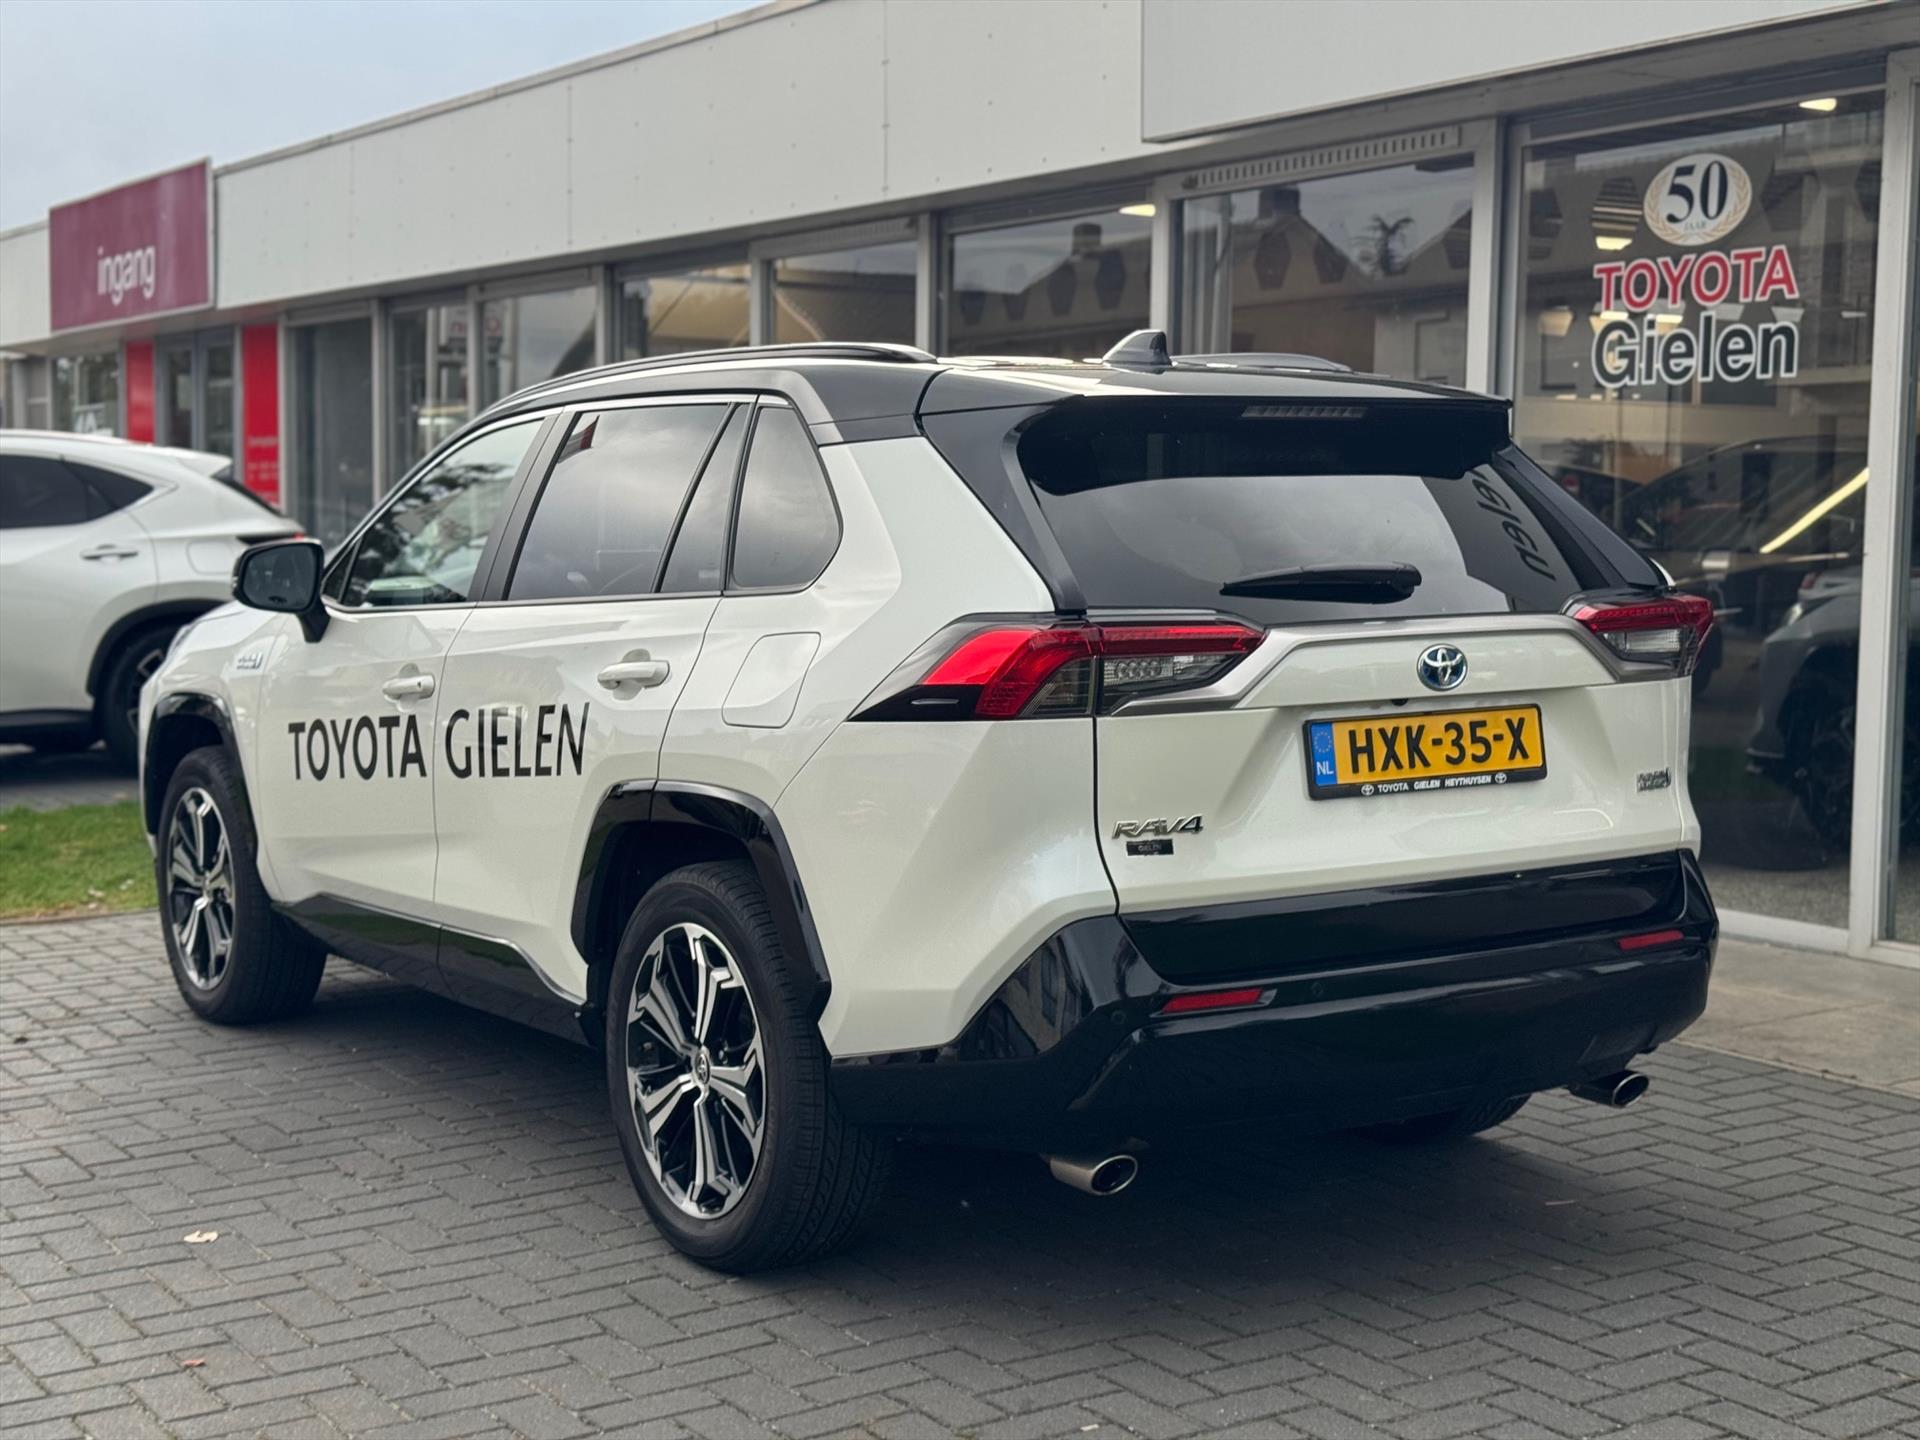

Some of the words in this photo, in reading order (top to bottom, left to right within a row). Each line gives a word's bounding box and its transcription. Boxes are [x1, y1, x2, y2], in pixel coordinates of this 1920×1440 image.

[1665, 160, 1729, 224] 50
[97, 245, 156, 307] ingang
[1593, 245, 1799, 312] TOYOTA
[1592, 311, 1798, 388] Gielen
[288, 714, 427, 781] TOYOTA
[445, 701, 591, 779] GIELEN
[1316, 760, 1334, 776] NL
[1348, 716, 1530, 775] HXK-35-X
[1377, 783, 1409, 793] TOYOTA
[1413, 779, 1441, 790] GIELEN
[1444, 774, 1492, 787] HEYTHUYSEN
[1111, 813, 1204, 840] RAV4
